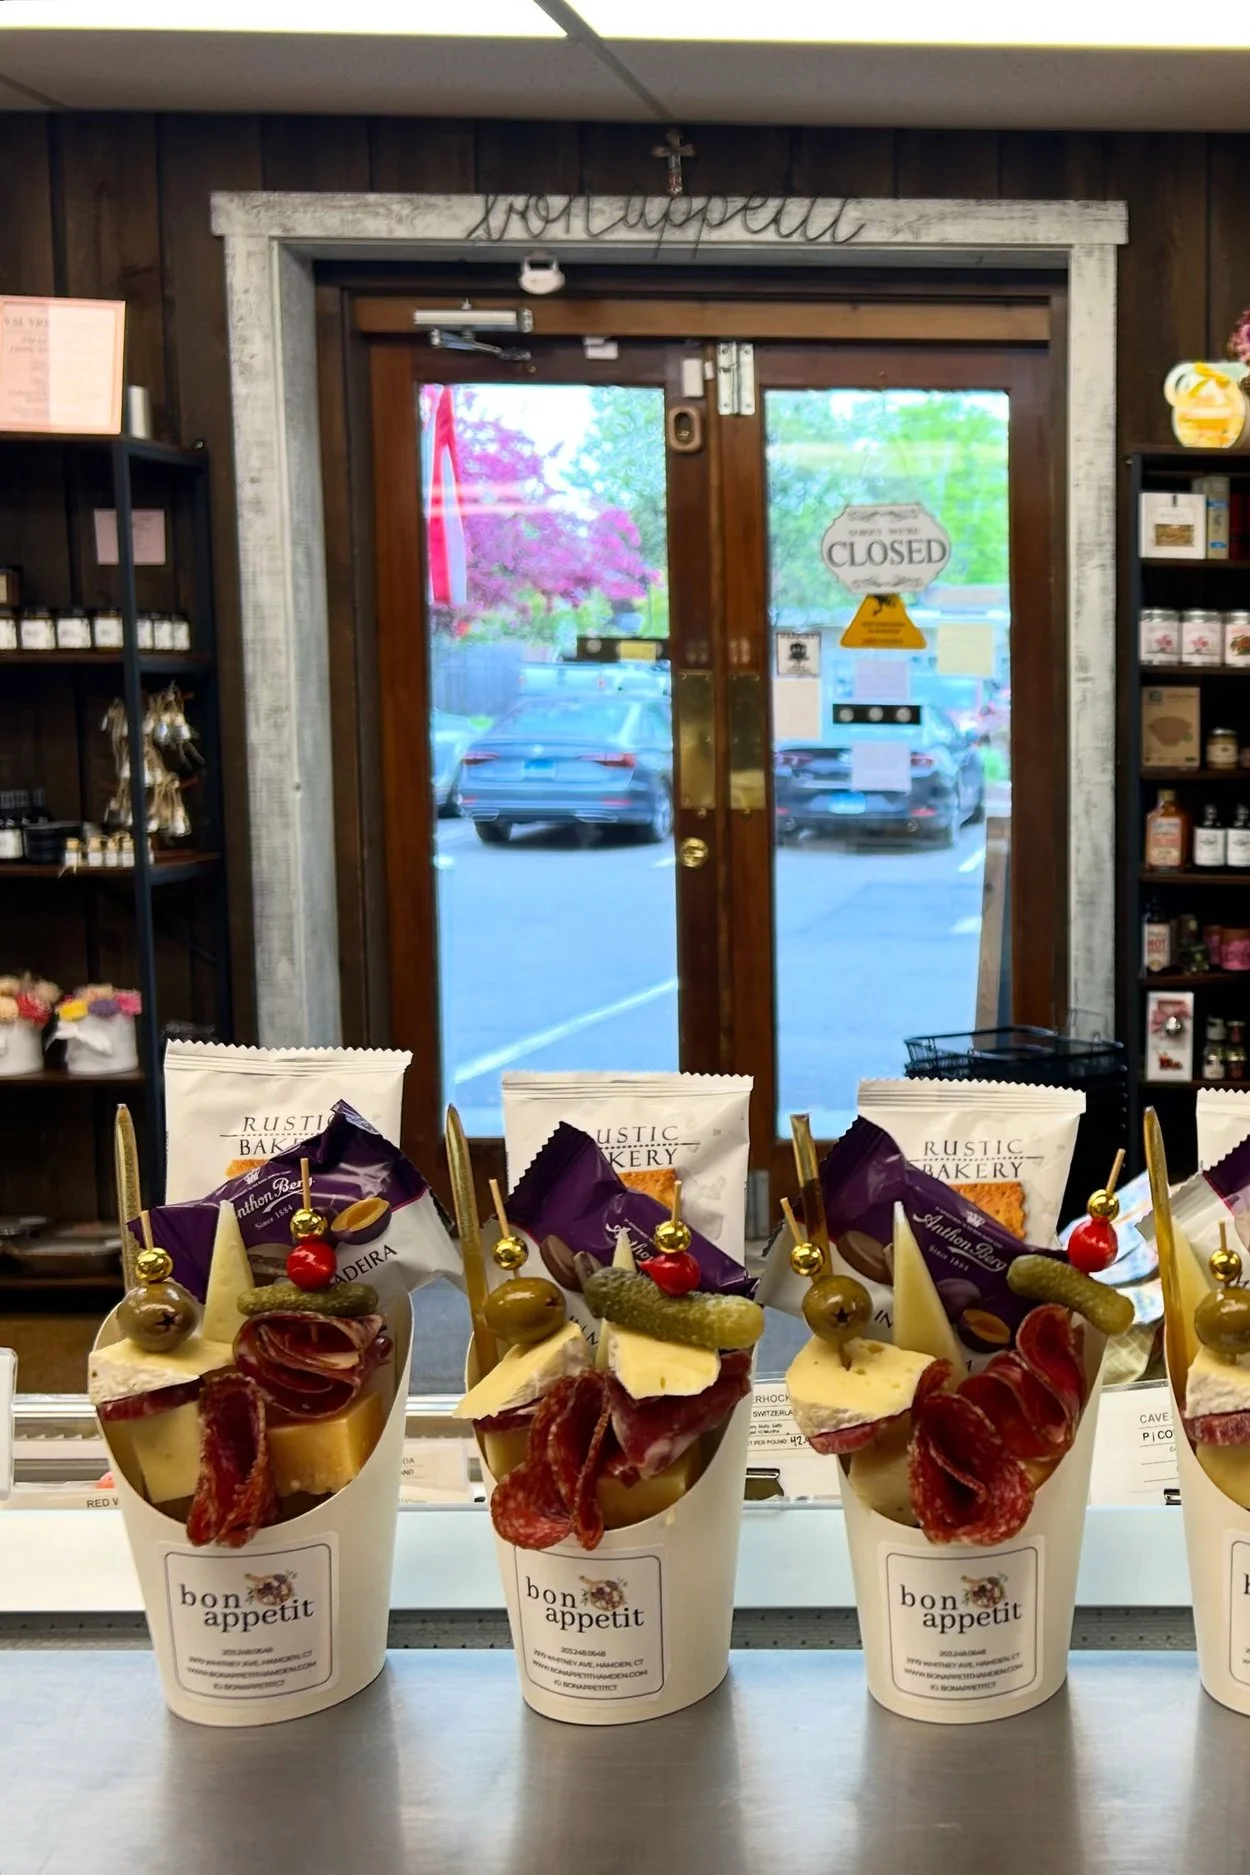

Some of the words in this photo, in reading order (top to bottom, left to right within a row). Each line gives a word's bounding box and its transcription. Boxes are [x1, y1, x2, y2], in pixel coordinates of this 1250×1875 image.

[827, 538, 947, 568] CLOSED
[239, 1137, 302, 1156] BAKE
[597, 1125, 680, 1145] USTIC
[924, 1138, 1024, 1157] RUSTIC
[608, 1148, 678, 1168] KERY
[922, 1161, 1024, 1180] BAKERY
[236, 1188, 274, 1220] nthon
[912, 1212, 973, 1253] Anthon
[969, 1241, 1008, 1272] Berg
[928, 1244, 948, 1261] Since
[333, 1244, 398, 1284] ADEIRA
[753, 1409, 793, 1417] SWITZERLA
[1157, 1429, 1174, 1440] CO
[86, 1498, 110, 1508] RED
[180, 1584, 242, 1609] bon
[525, 1576, 577, 1608] bon
[899, 1584, 958, 1611] bon
[203, 1600, 314, 1632] appetit
[545, 1608, 645, 1633] appetit
[922, 1602, 1023, 1634] appetit
